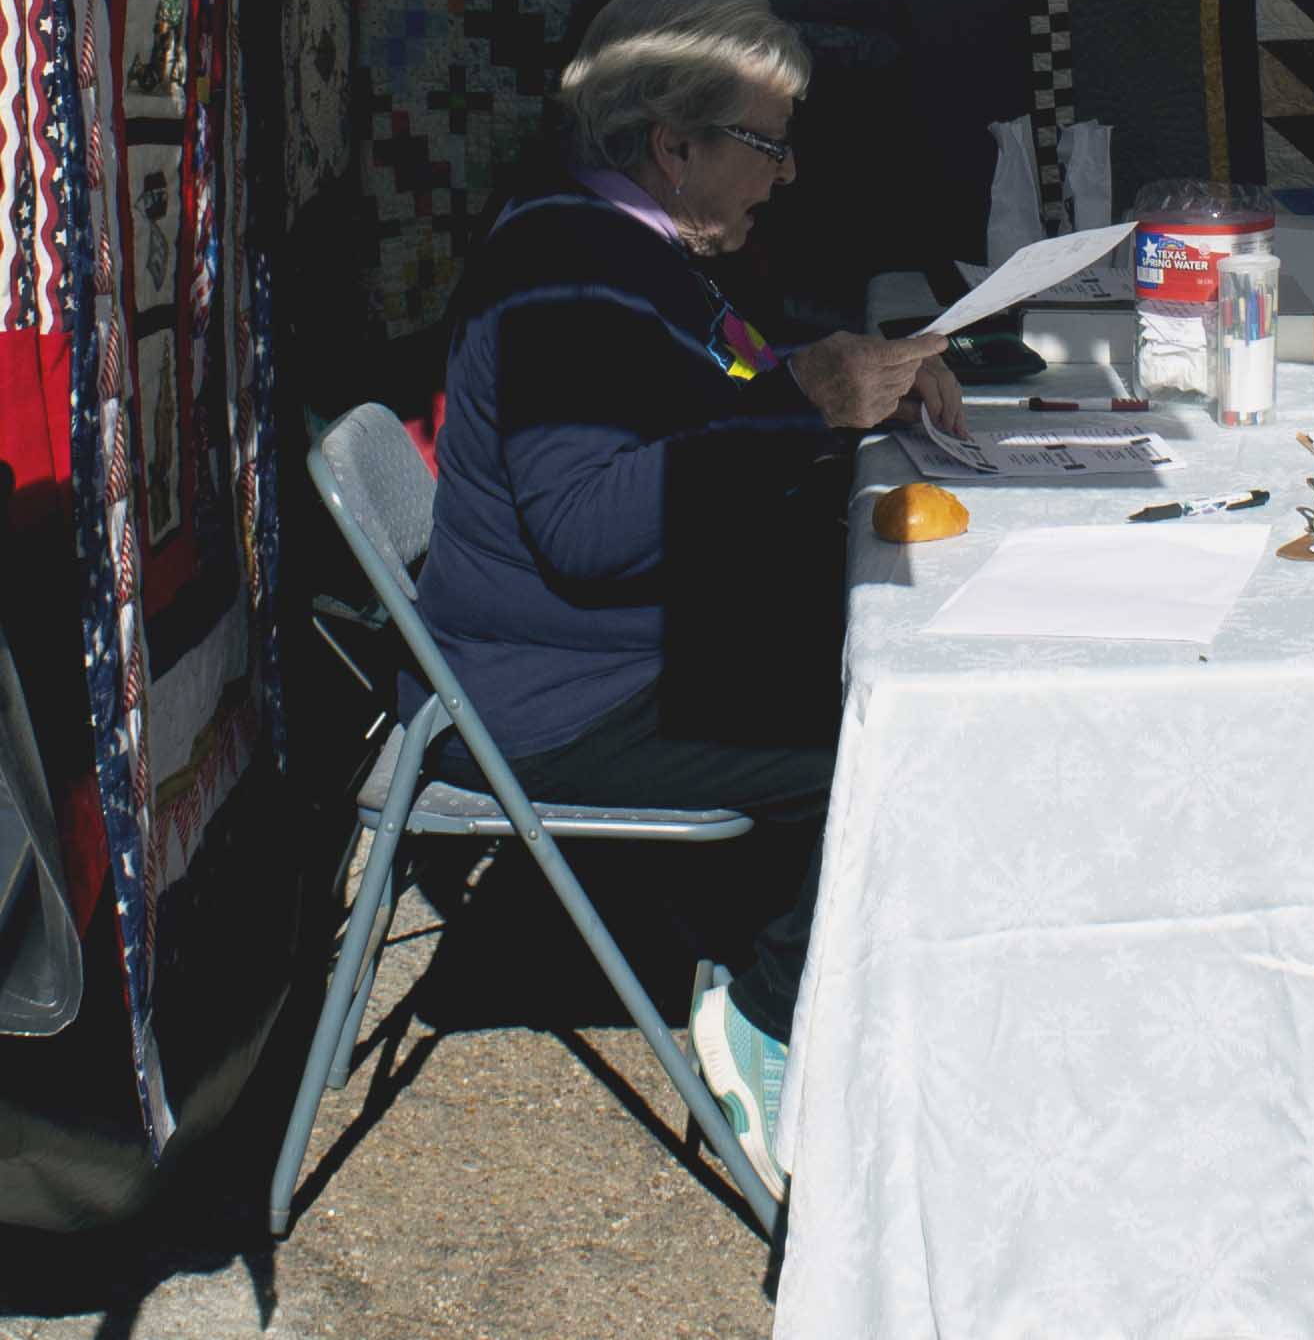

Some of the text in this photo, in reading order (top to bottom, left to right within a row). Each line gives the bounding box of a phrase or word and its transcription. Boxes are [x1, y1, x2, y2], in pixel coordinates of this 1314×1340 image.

[1156, 249, 1188, 261] TEXAS
[1142, 258, 1209, 271] SPRING WATER
